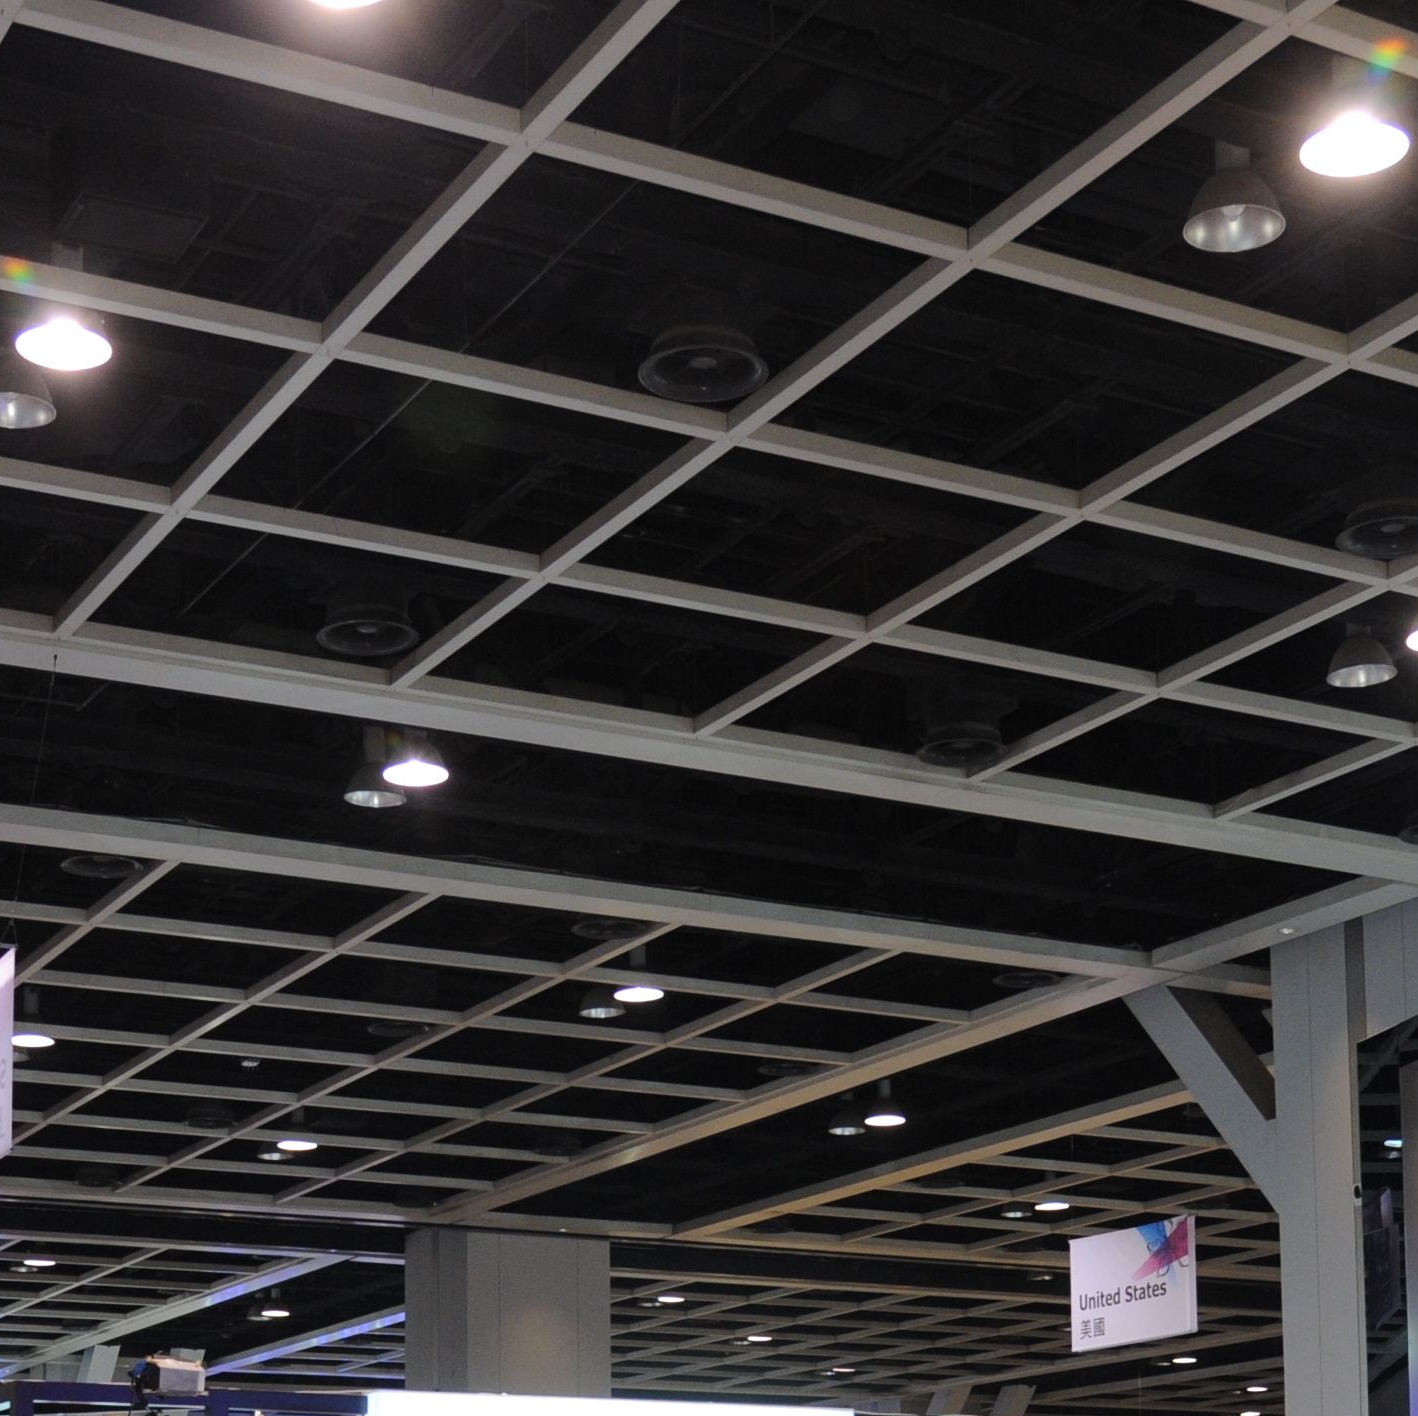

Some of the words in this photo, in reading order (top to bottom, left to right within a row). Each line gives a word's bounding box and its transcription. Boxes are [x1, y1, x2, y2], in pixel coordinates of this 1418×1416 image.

[1079, 1287, 1121, 1311] United
[1124, 1281, 1167, 1303] States
[1081, 1317, 1106, 1340] 美國
